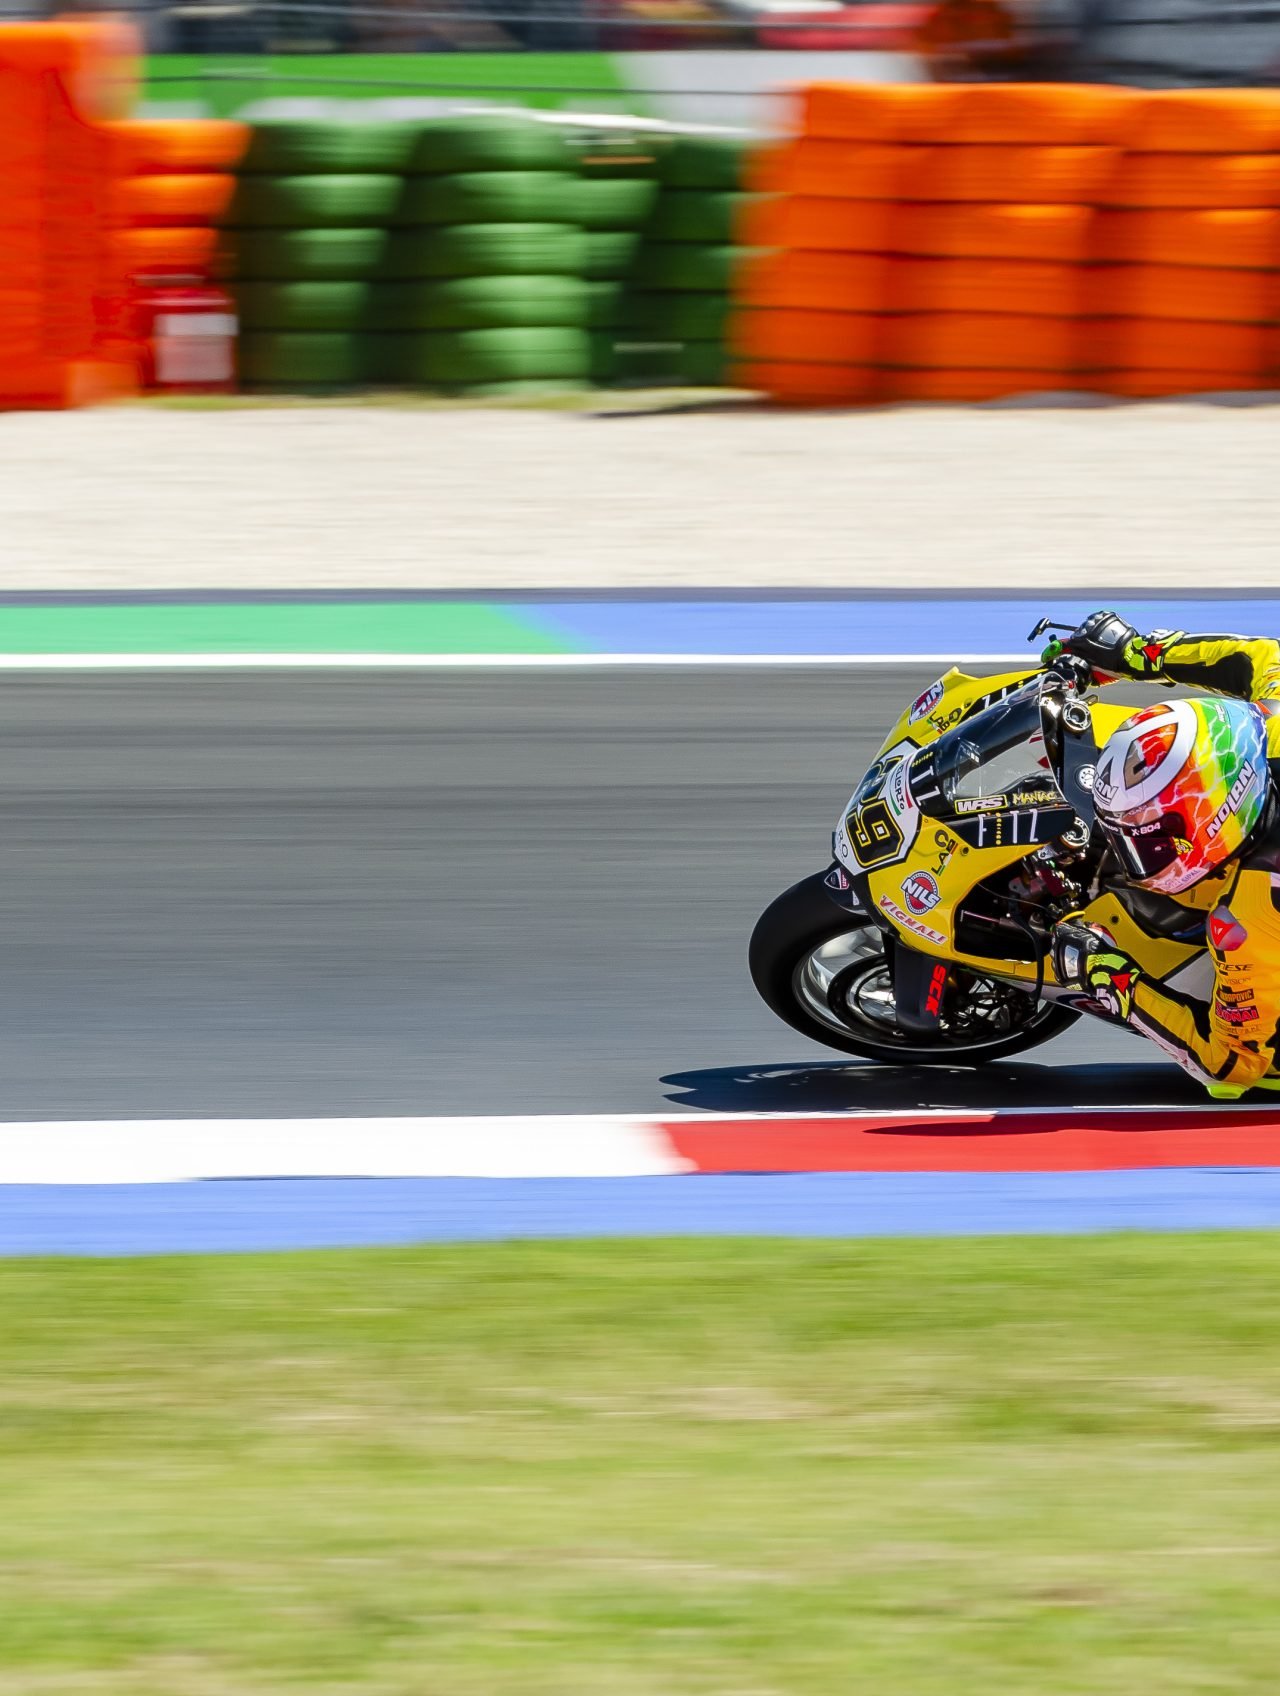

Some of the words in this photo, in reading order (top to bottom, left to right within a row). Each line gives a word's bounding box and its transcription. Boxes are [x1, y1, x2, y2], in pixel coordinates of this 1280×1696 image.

[957, 797, 1003, 812] WRS
[1206, 759, 1256, 839] NOLAN
[901, 878, 942, 909] NILS
[879, 896, 947, 943] VIGNALI
